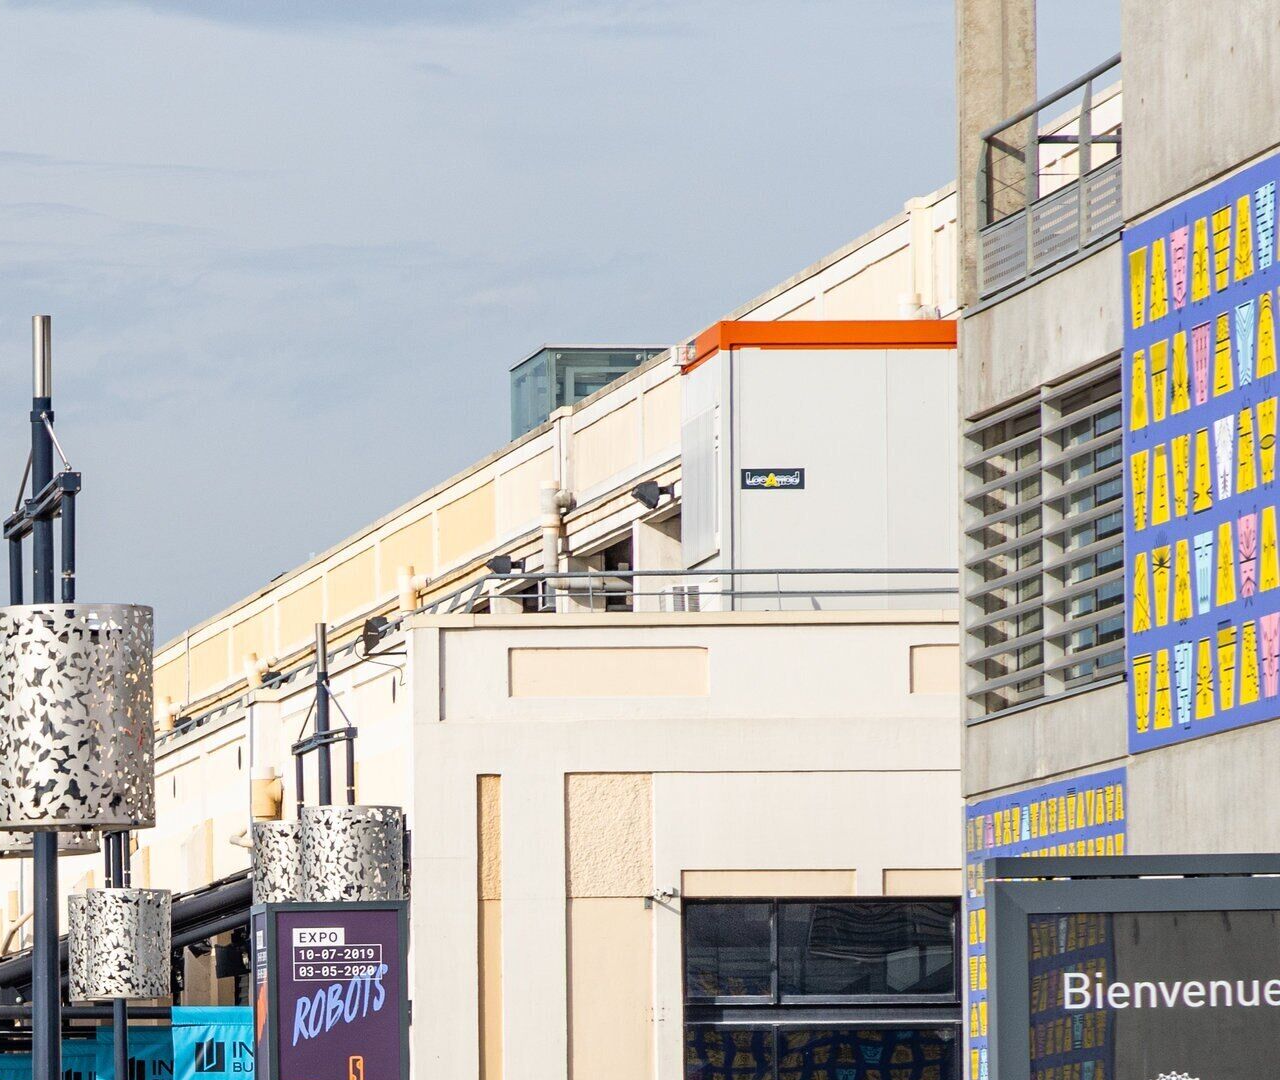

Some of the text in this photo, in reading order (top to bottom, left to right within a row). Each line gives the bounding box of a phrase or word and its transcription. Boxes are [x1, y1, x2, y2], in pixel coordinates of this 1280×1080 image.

[299, 932, 338, 943] EXPO
[299, 949, 375, 960] 10-07-2019
[299, 966, 375, 976] 03-05-2020
[1064, 972, 1280, 1009] Bienvenue
[292, 964, 389, 1047] ROBOTS
